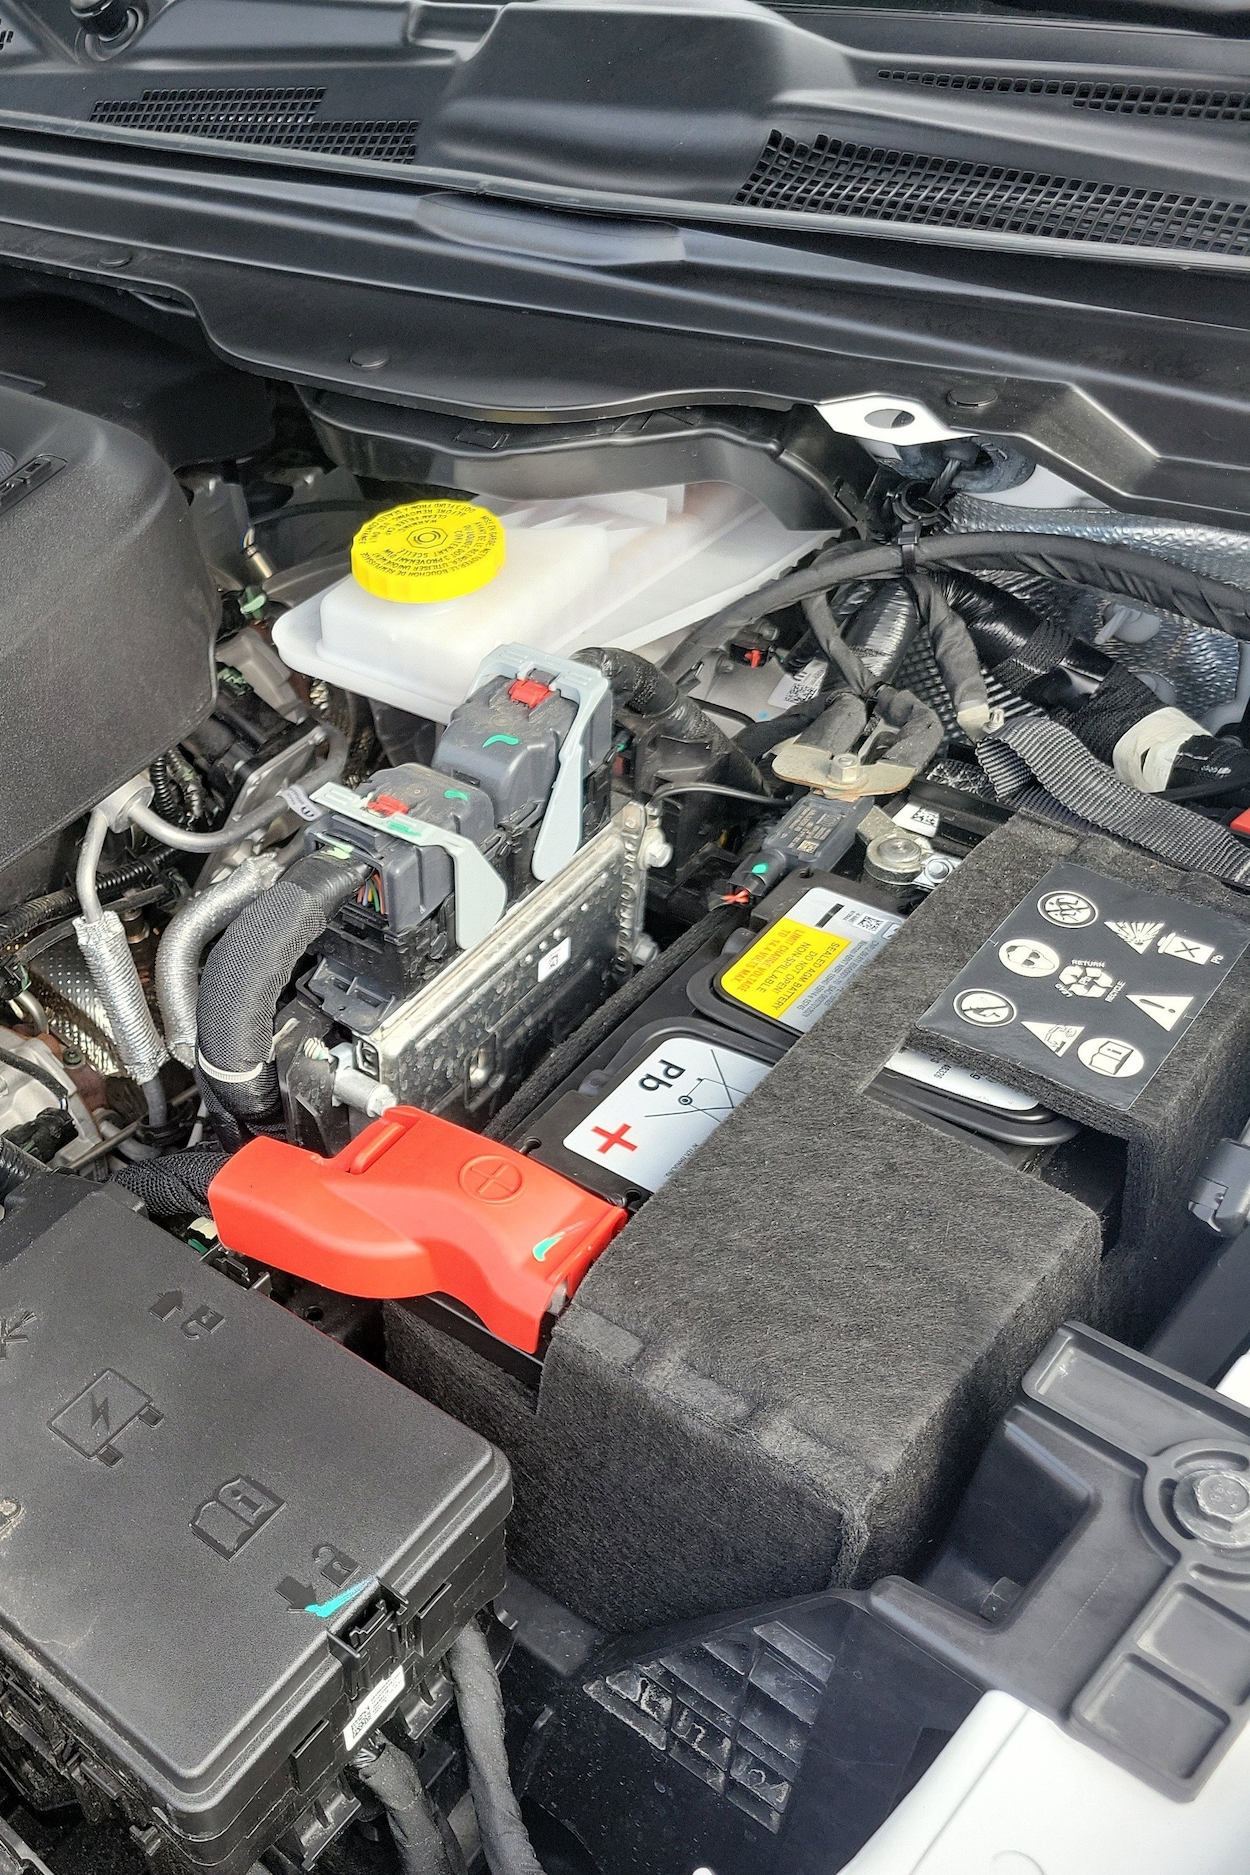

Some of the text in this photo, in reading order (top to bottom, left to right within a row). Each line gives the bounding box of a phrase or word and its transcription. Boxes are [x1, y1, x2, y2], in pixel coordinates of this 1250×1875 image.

[776, 928, 789, 938] TO
[736, 928, 804, 993] LIMIT CHARGE VOLTAGE
[745, 949, 767, 969] VOLTS
[811, 941, 839, 968] SEALED
[1071, 959, 1105, 968] RETURN
[1211, 954, 1224, 965] Pb
[755, 941, 810, 994] NON-SPILLABLE
[772, 950, 817, 994] DO NOT OPEN!
[798, 967, 814, 982] AGM
[770, 981, 801, 1010] BATTERY
[1104, 980, 1127, 1003] RECYCLE
[638, 1059, 686, 1092] Pb
